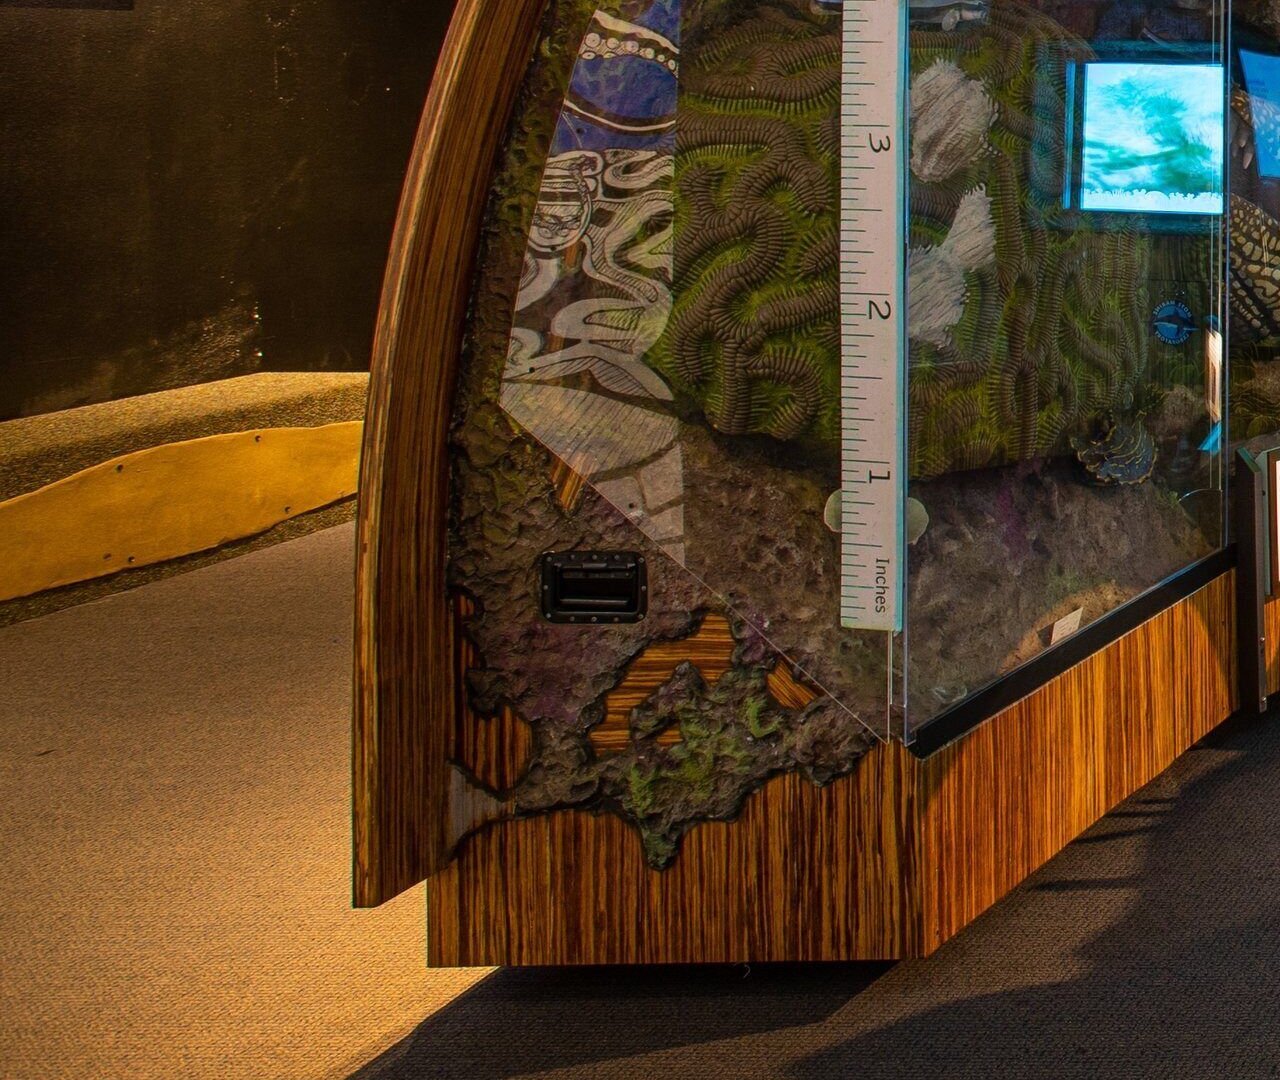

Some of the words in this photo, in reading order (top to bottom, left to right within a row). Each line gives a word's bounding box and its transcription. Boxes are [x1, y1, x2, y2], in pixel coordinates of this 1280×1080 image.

[869, 133, 891, 154] 3
[868, 300, 892, 321] 2
[869, 469, 891, 485] 1
[875, 558, 890, 613] Inches
